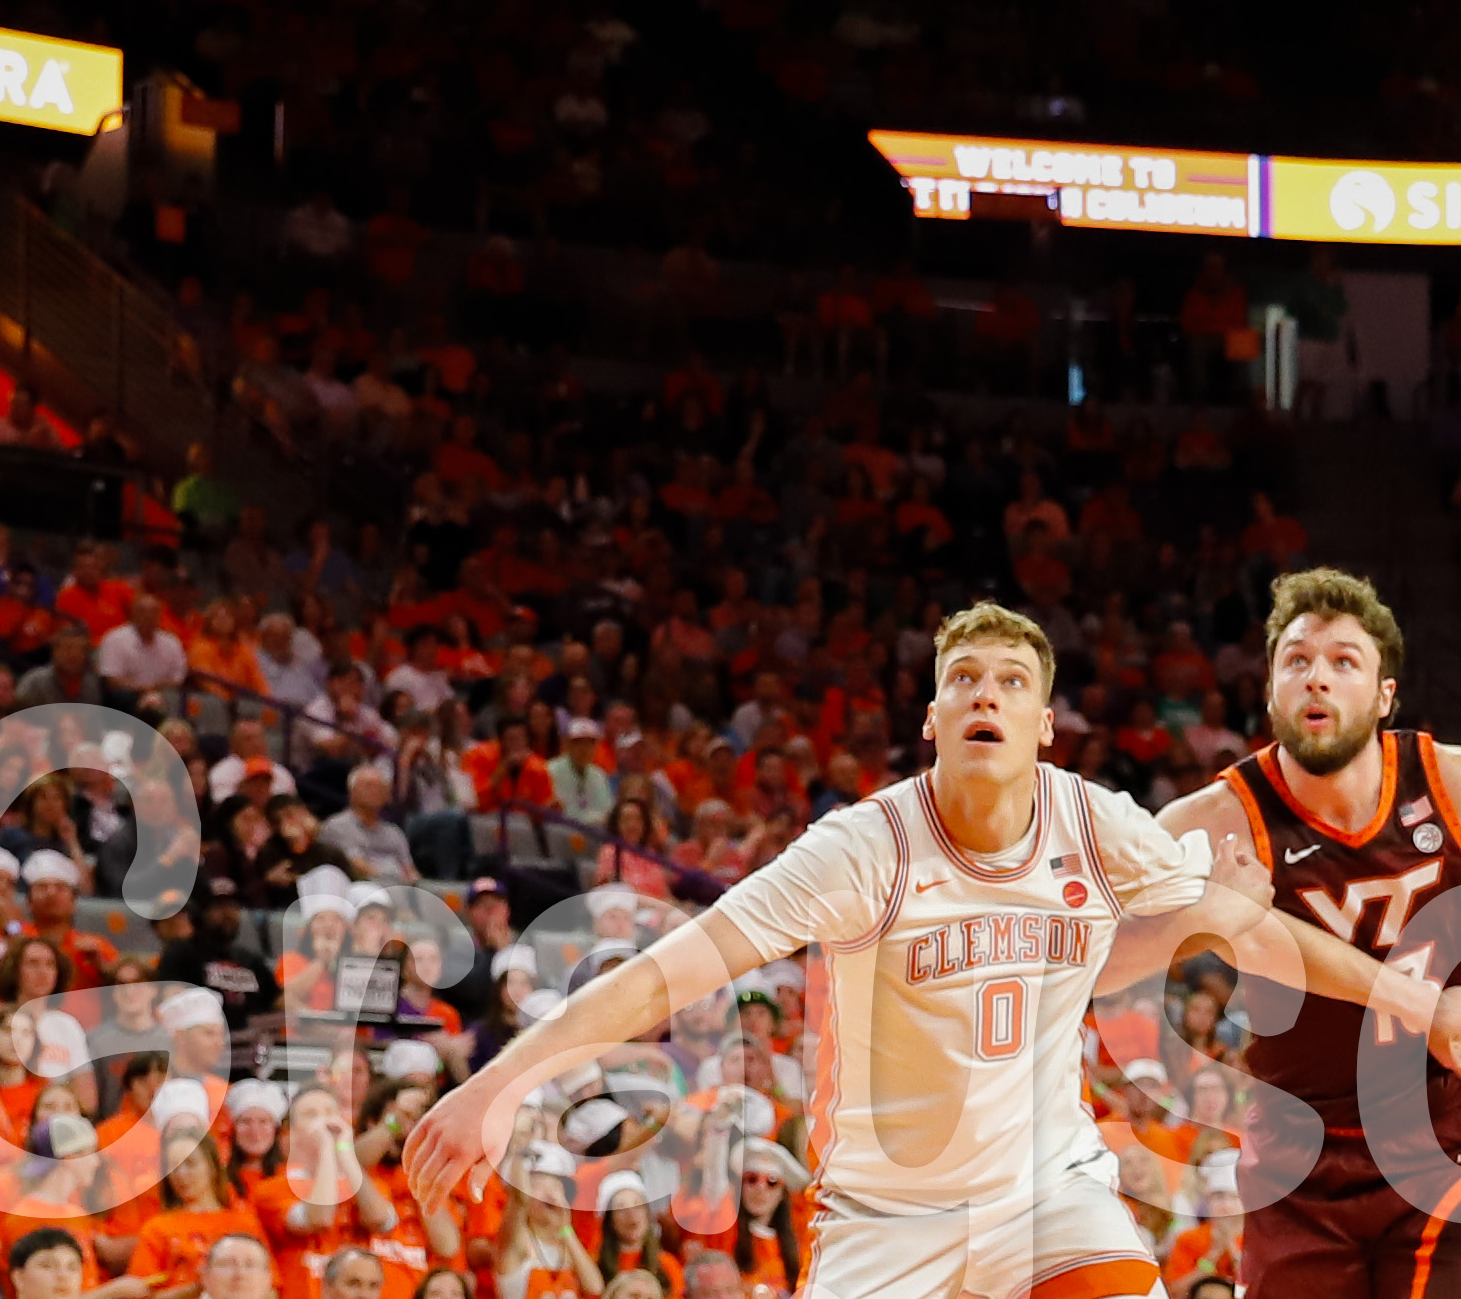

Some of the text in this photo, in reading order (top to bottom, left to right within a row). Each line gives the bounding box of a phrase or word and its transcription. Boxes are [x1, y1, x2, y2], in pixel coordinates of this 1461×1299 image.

[1296, 857, 1443, 948] VT
[905, 913, 1092, 986] CLEMSON
[974, 975, 1028, 1062] 0
